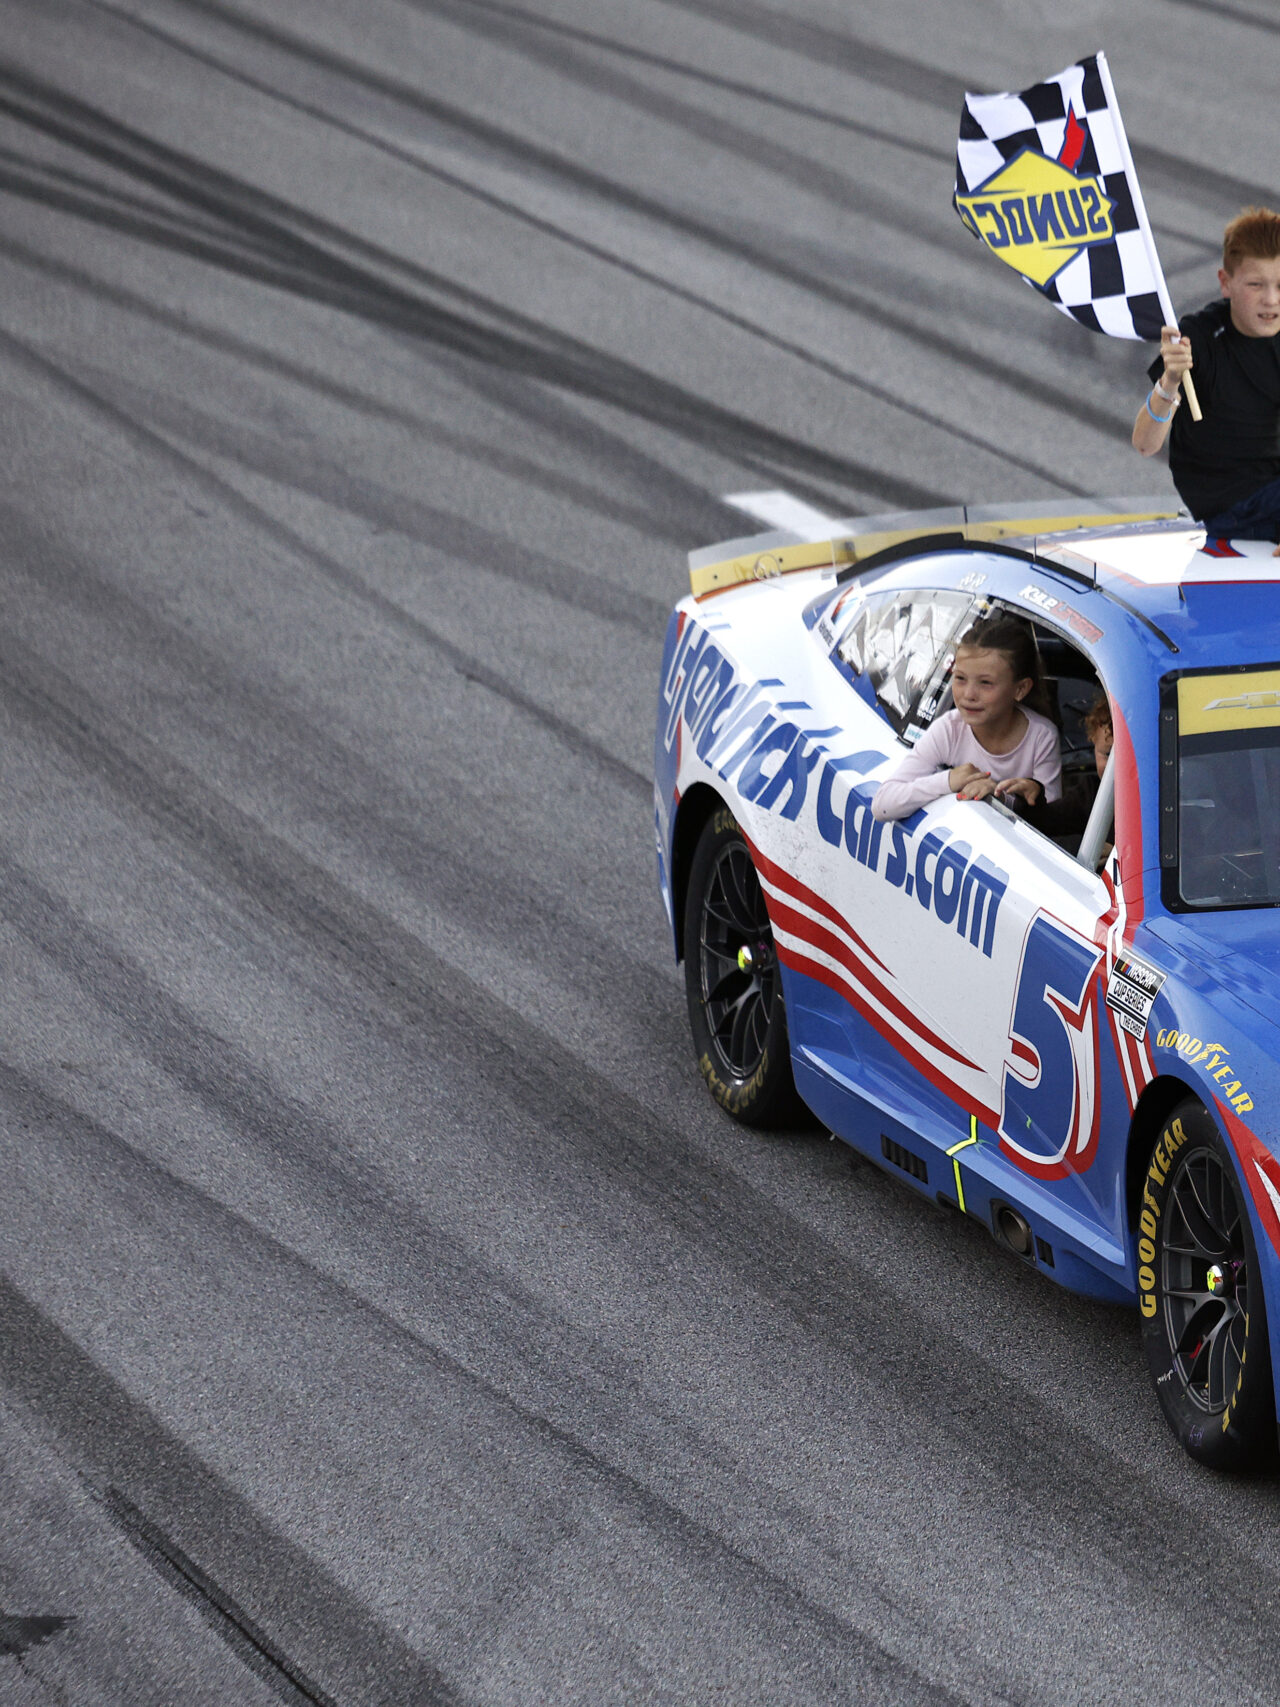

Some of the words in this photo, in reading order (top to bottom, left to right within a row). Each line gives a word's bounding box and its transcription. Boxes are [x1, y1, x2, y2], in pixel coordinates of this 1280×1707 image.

[1113, 980, 1128, 998] CUP
[1125, 988, 1147, 1012] SERIES
[1127, 962, 1157, 990] NASCAR
[997, 907, 1105, 1172] 5
[1156, 1028, 1254, 1115] GOODYEAR
[1138, 1117, 1188, 1318] GOODYEAR
